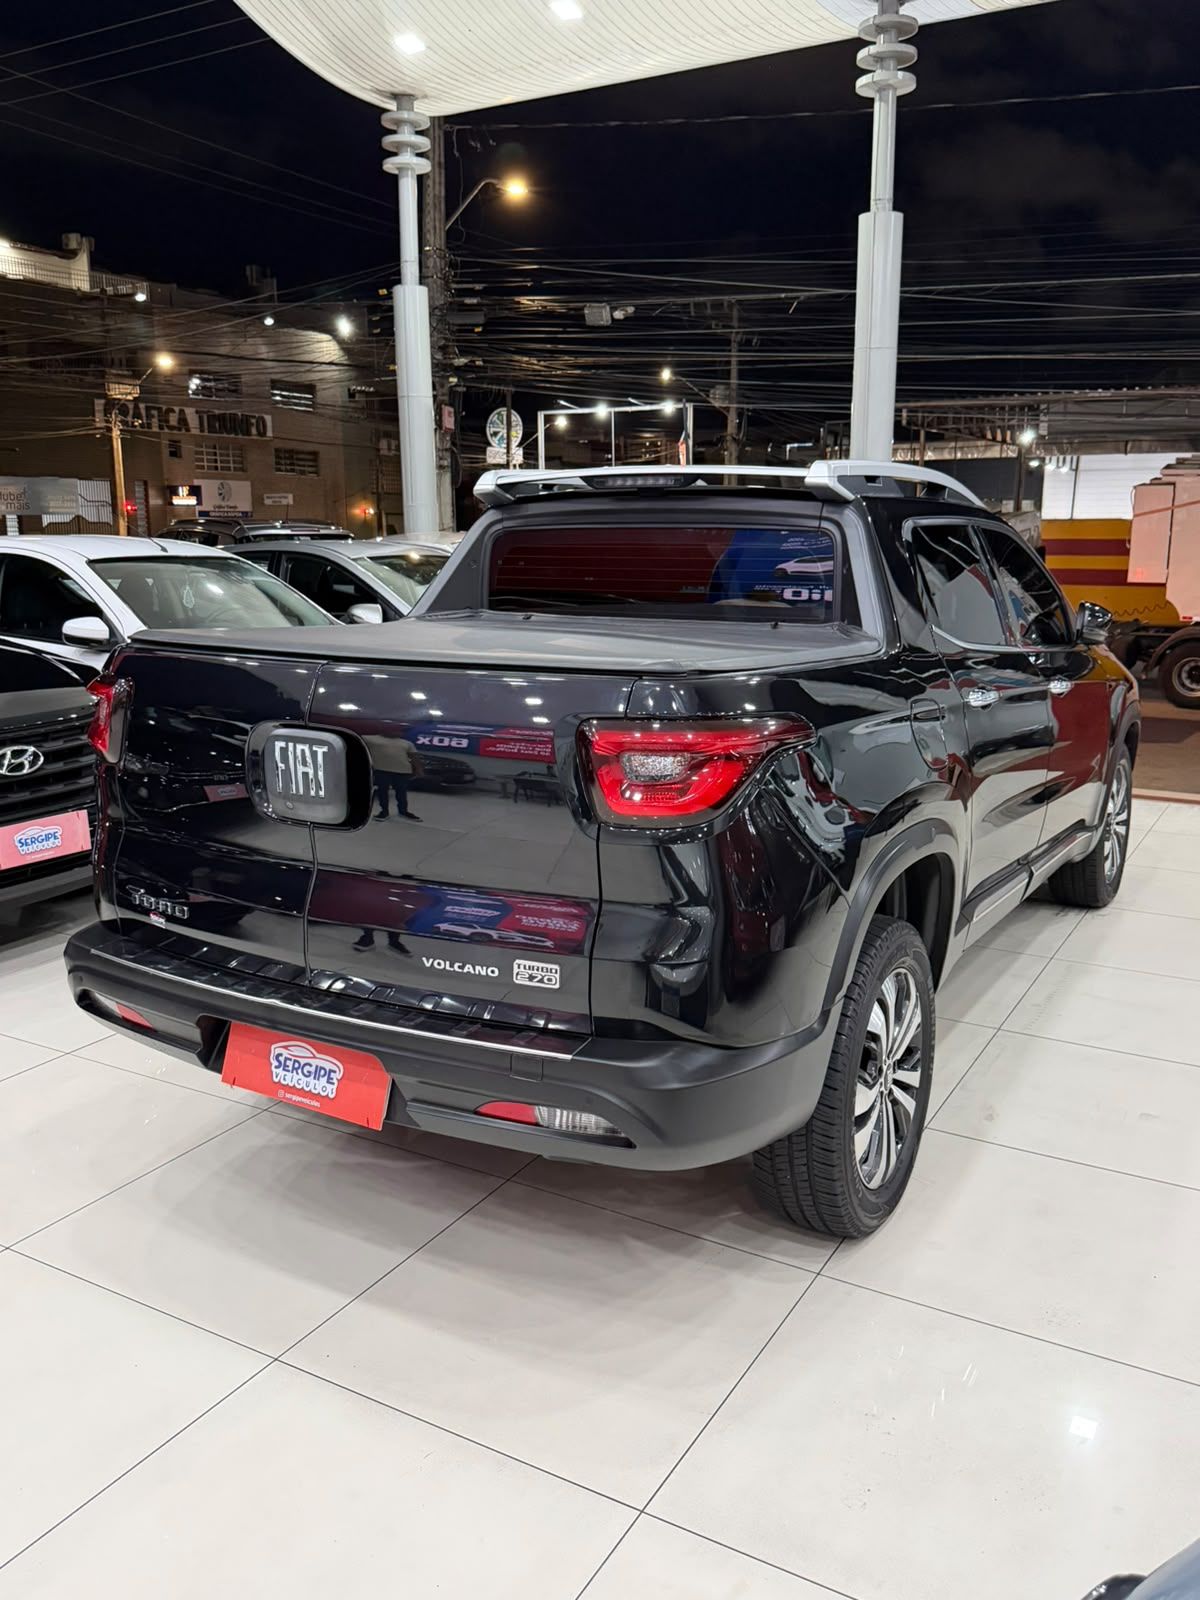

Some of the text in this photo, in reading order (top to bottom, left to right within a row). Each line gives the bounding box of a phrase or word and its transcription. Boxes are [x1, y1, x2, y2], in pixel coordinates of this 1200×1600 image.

[275, 741, 328, 798] FIAT
[18, 831, 59, 848] SERGIPE
[422, 956, 499, 977] VOLCANO
[516, 962, 558, 974] TURBO
[516, 971, 558, 986] 270
[274, 1053, 337, 1085] SERGIPE
